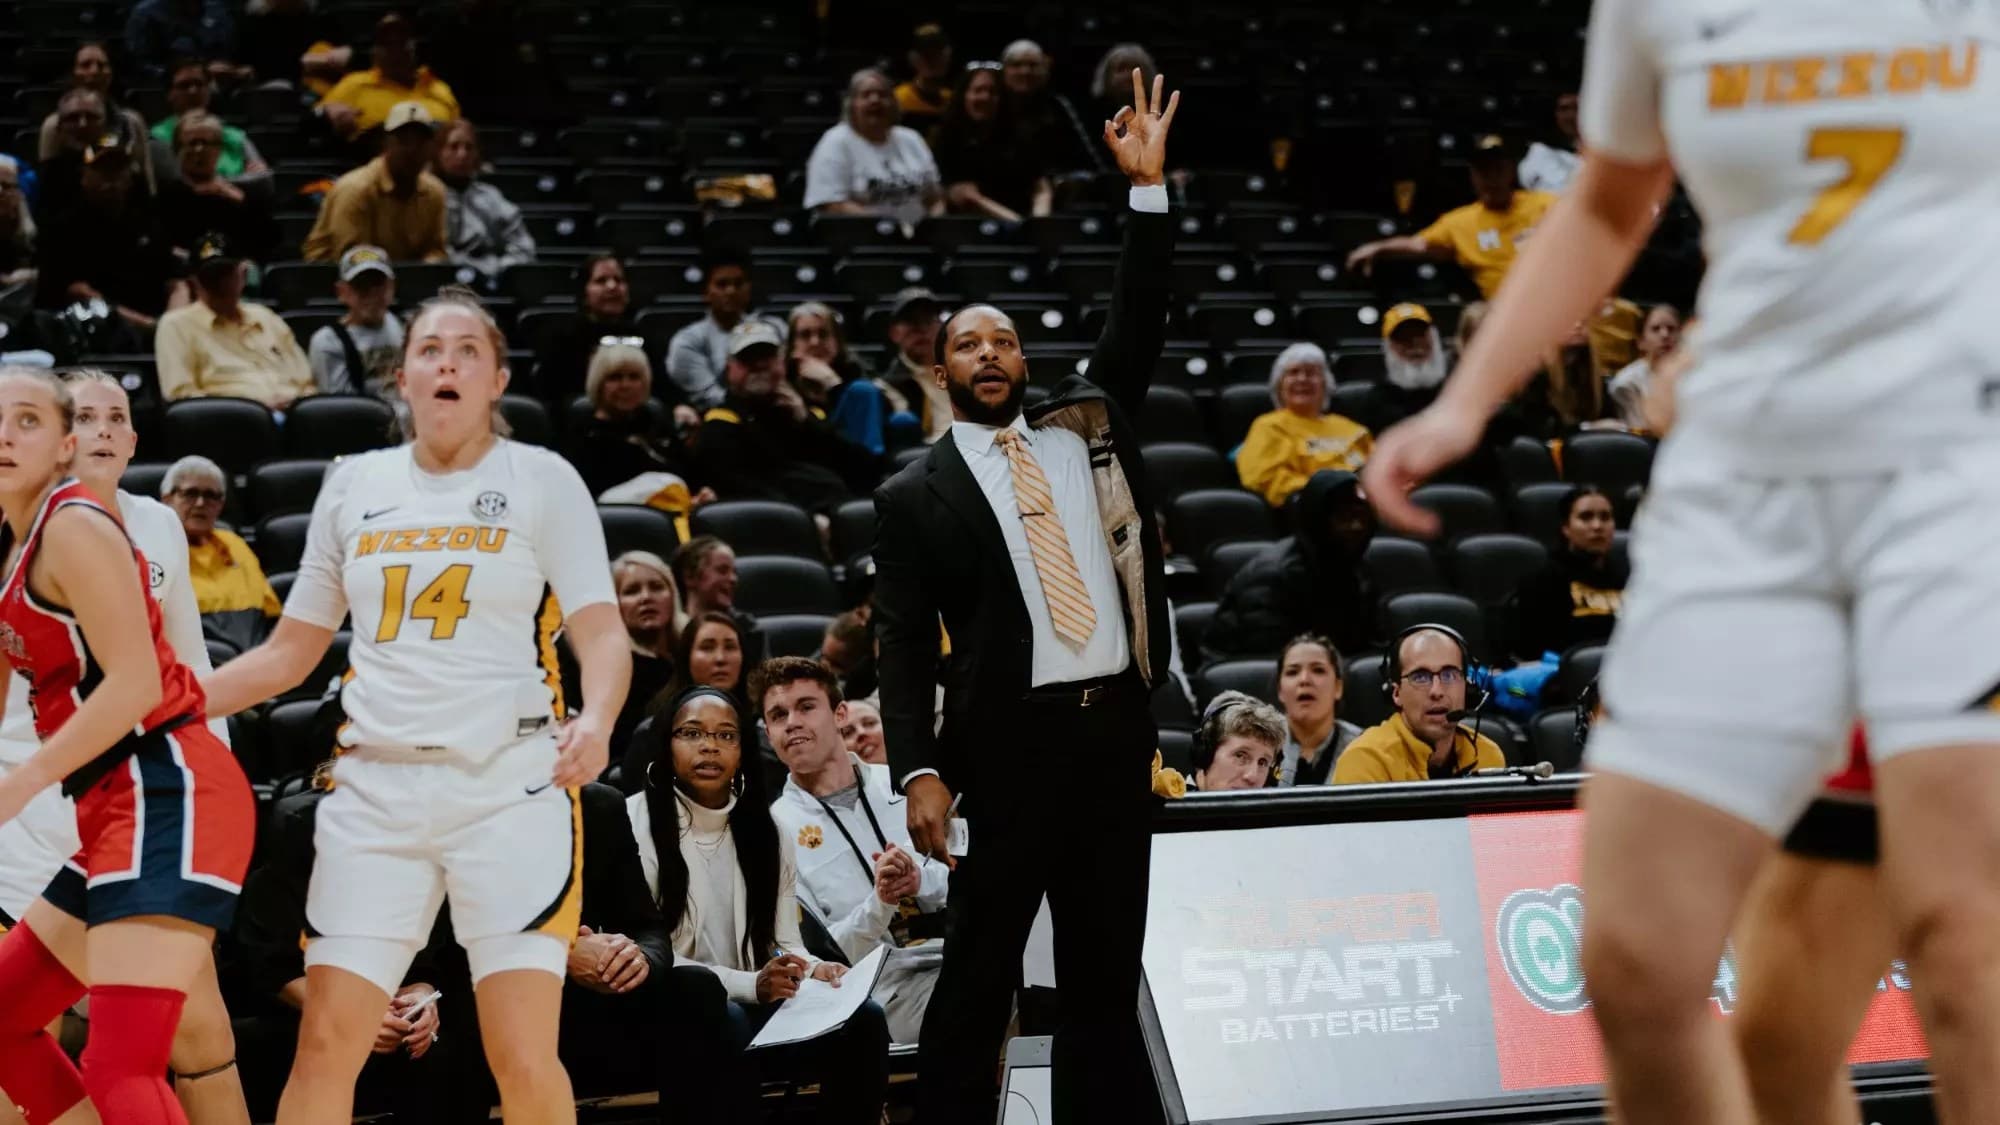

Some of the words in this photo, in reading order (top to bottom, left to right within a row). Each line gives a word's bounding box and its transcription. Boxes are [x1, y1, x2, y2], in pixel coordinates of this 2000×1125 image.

[1706, 38, 1980, 112] MIZZOU
[1785, 127, 1908, 246] 7
[354, 525, 510, 560] MIZZOU
[375, 563, 474, 644] 14
[1182, 939, 1460, 1010] START
[1220, 1004, 1440, 1043] BATTERIES
